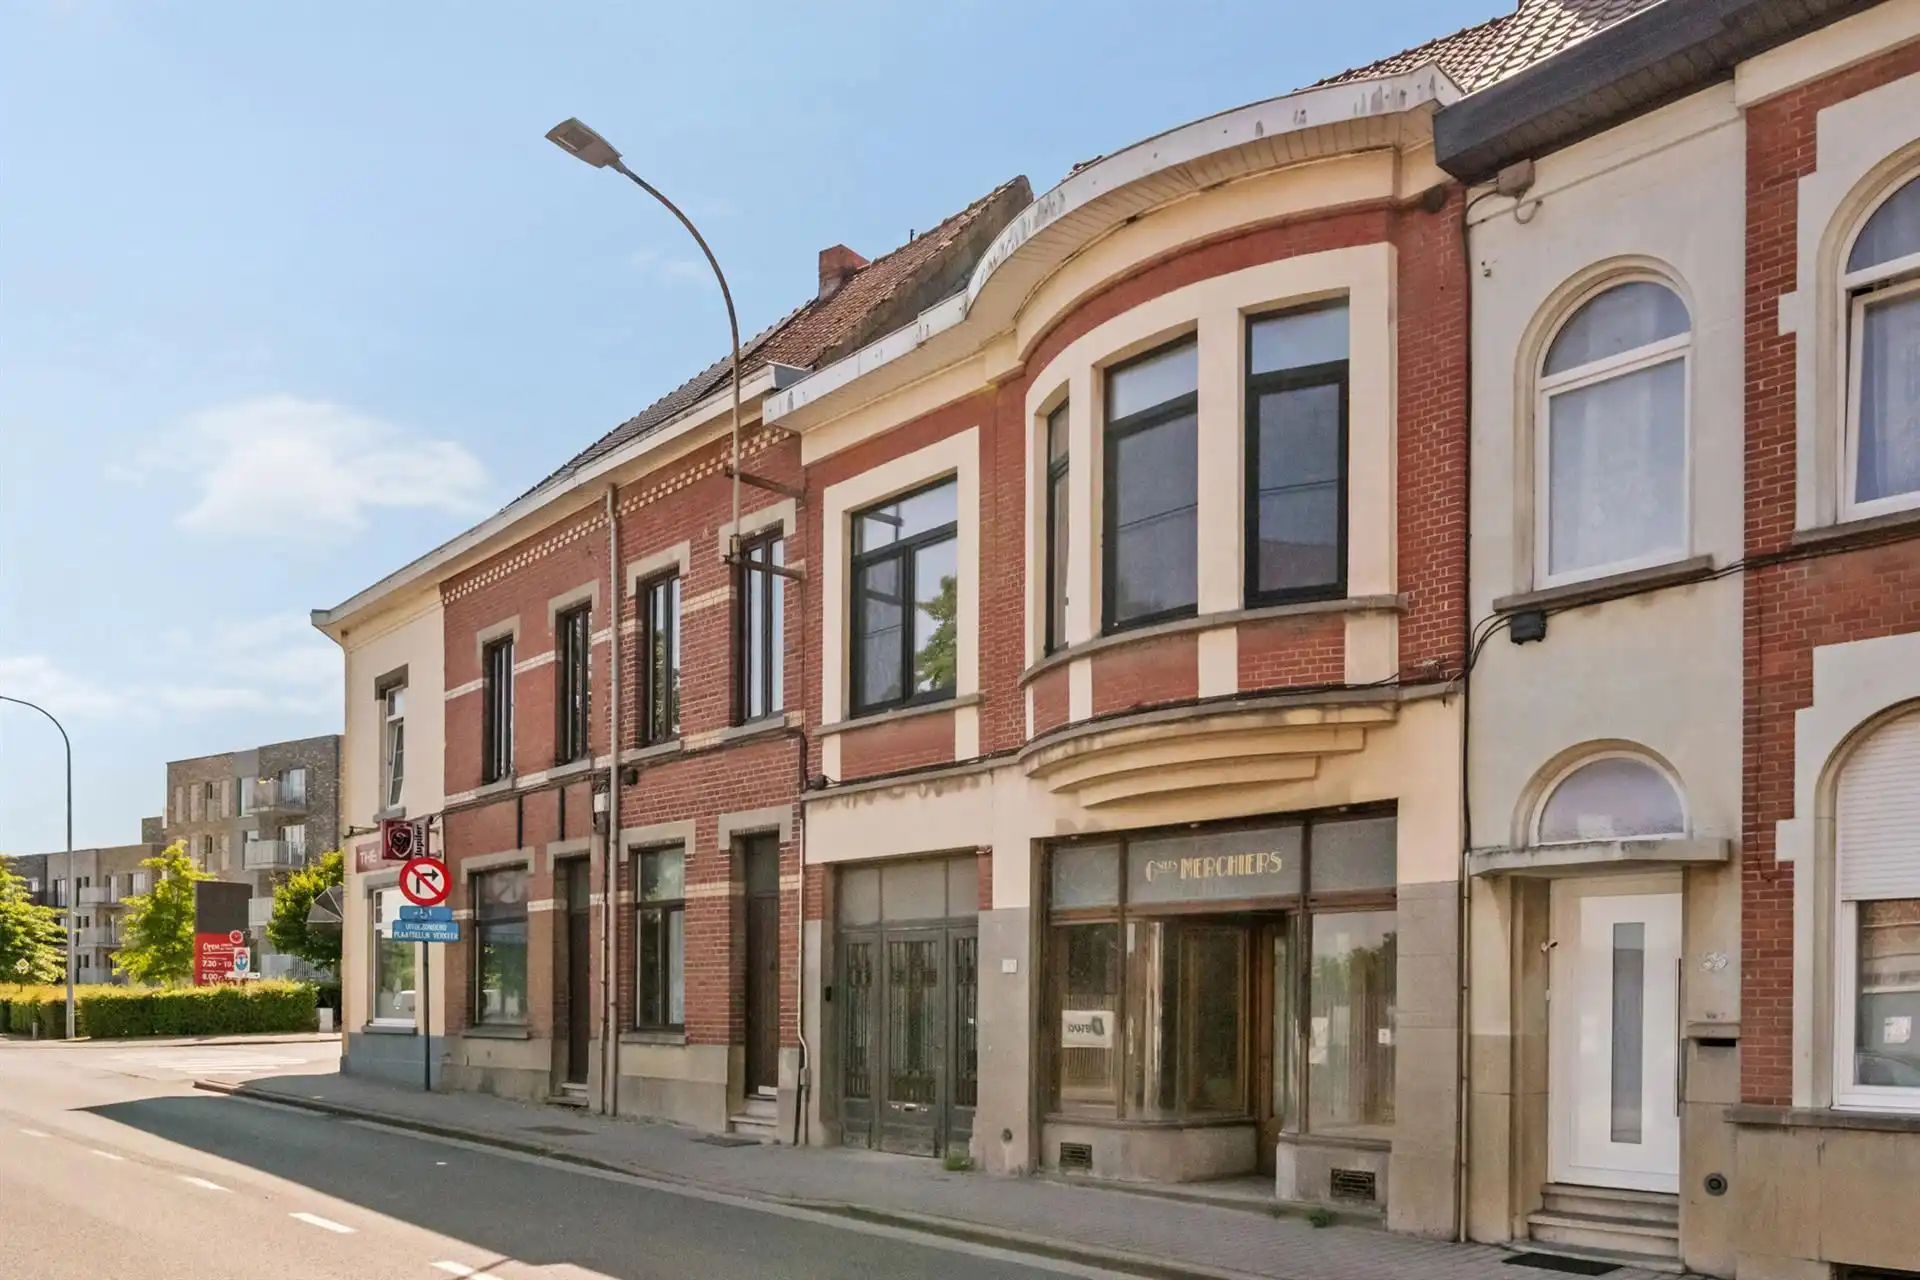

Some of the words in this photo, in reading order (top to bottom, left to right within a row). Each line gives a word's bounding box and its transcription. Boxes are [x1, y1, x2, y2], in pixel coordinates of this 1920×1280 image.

[415, 824, 425, 857] Jupiler
[360, 849, 378, 865] THE
[1180, 851, 1282, 880] MERCHIERS
